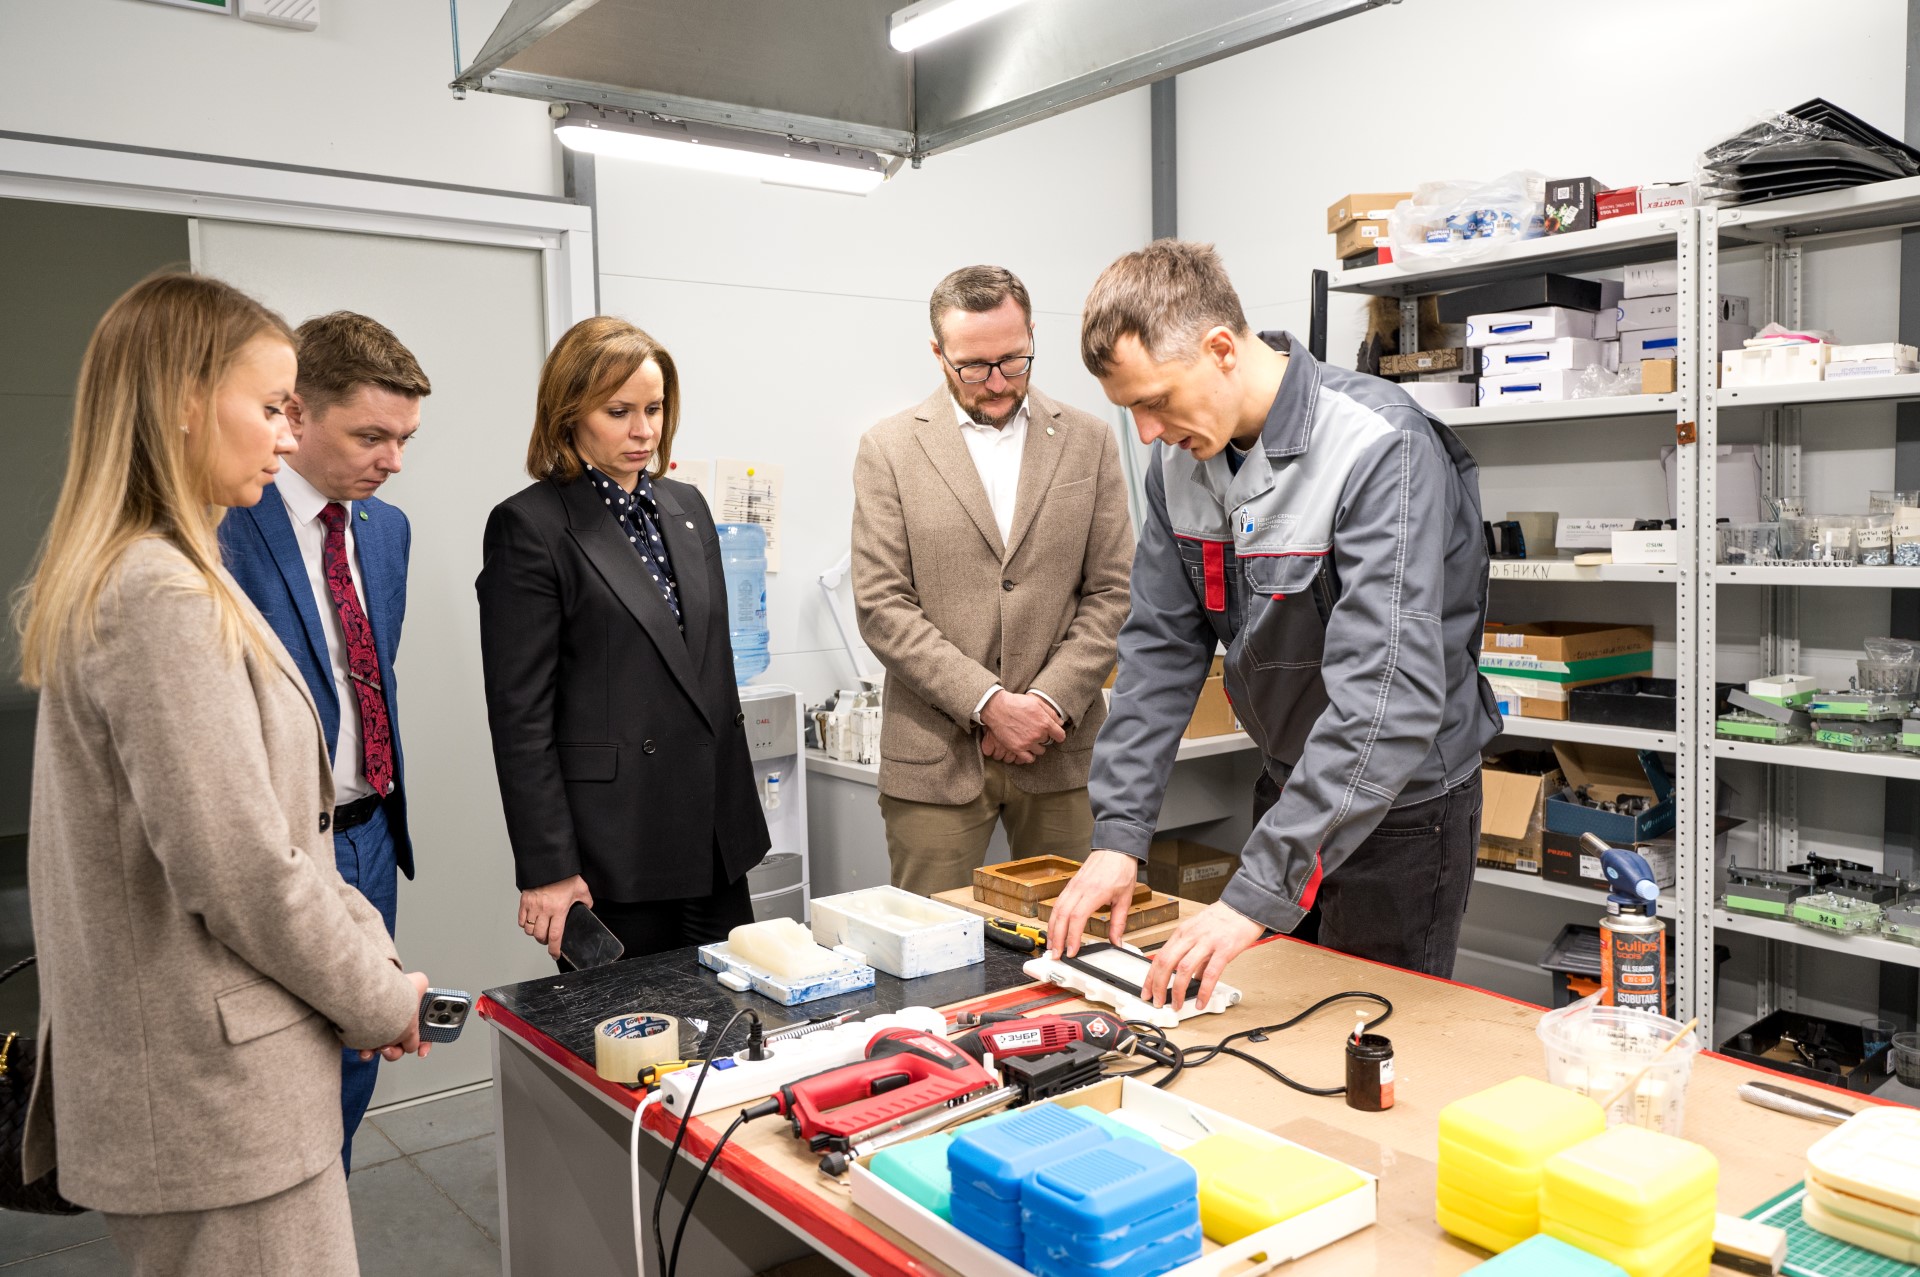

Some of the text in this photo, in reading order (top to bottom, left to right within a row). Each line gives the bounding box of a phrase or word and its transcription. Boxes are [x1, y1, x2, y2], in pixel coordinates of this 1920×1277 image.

[1647, 199, 1685, 209] WORTEX
[1616, 940, 1657, 955] tulips
[1616, 951, 1642, 959] tools
[1617, 993, 1659, 1004] ISOBUTANE
[1008, 1031, 1038, 1042] ЗУБР
